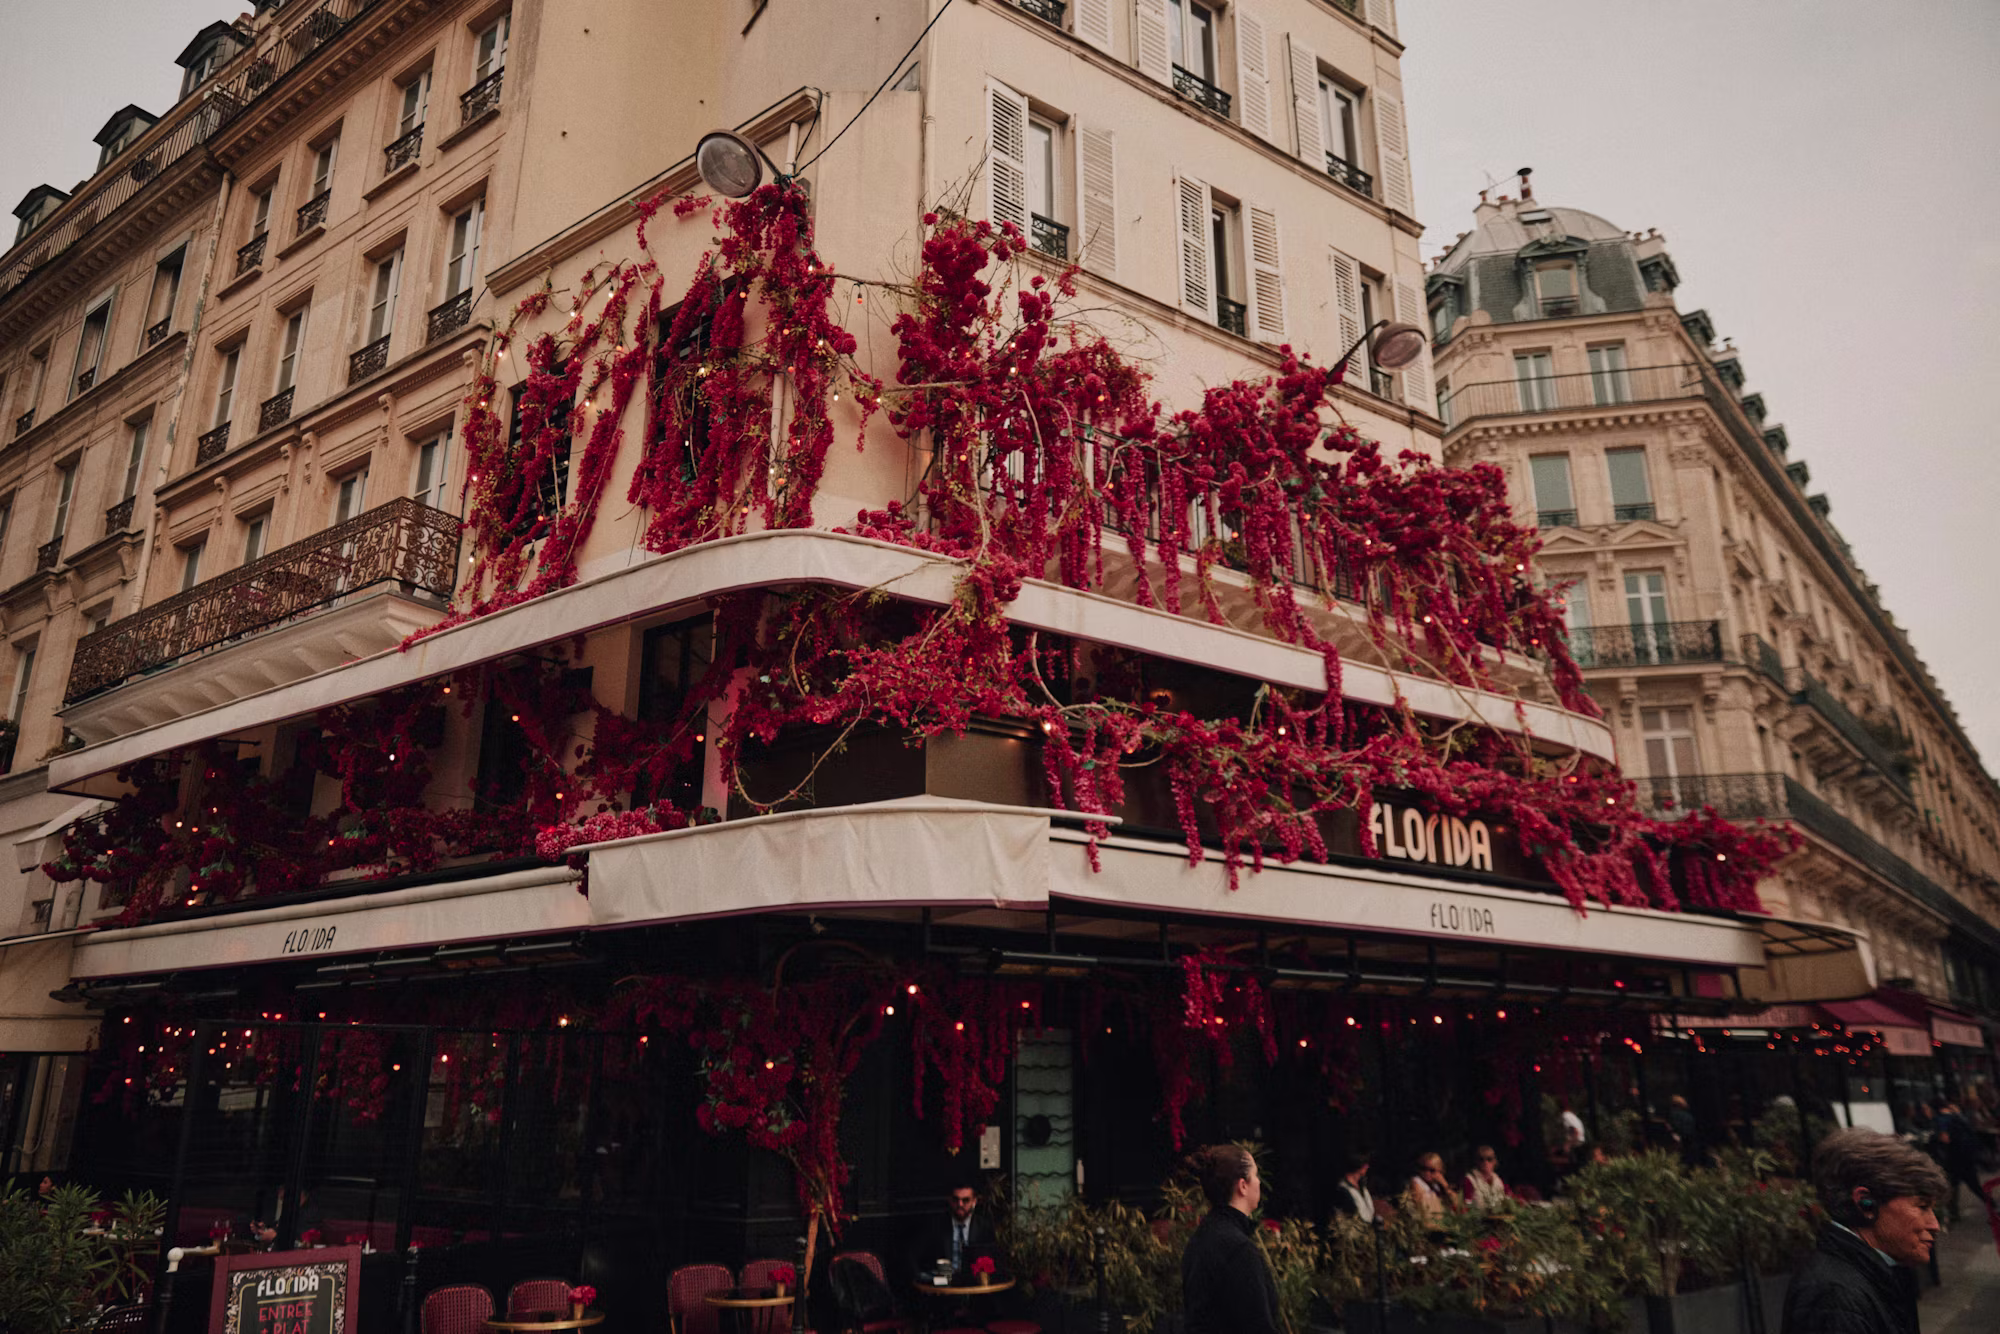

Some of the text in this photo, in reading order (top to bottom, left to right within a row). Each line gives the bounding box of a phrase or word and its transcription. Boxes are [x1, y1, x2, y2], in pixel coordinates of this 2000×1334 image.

[1368, 802, 1493, 871] FLORIDA
[1431, 903, 1495, 934] FLORIDA
[282, 925, 336, 954] FLORIDA
[257, 1274, 319, 1297] FLORIDA
